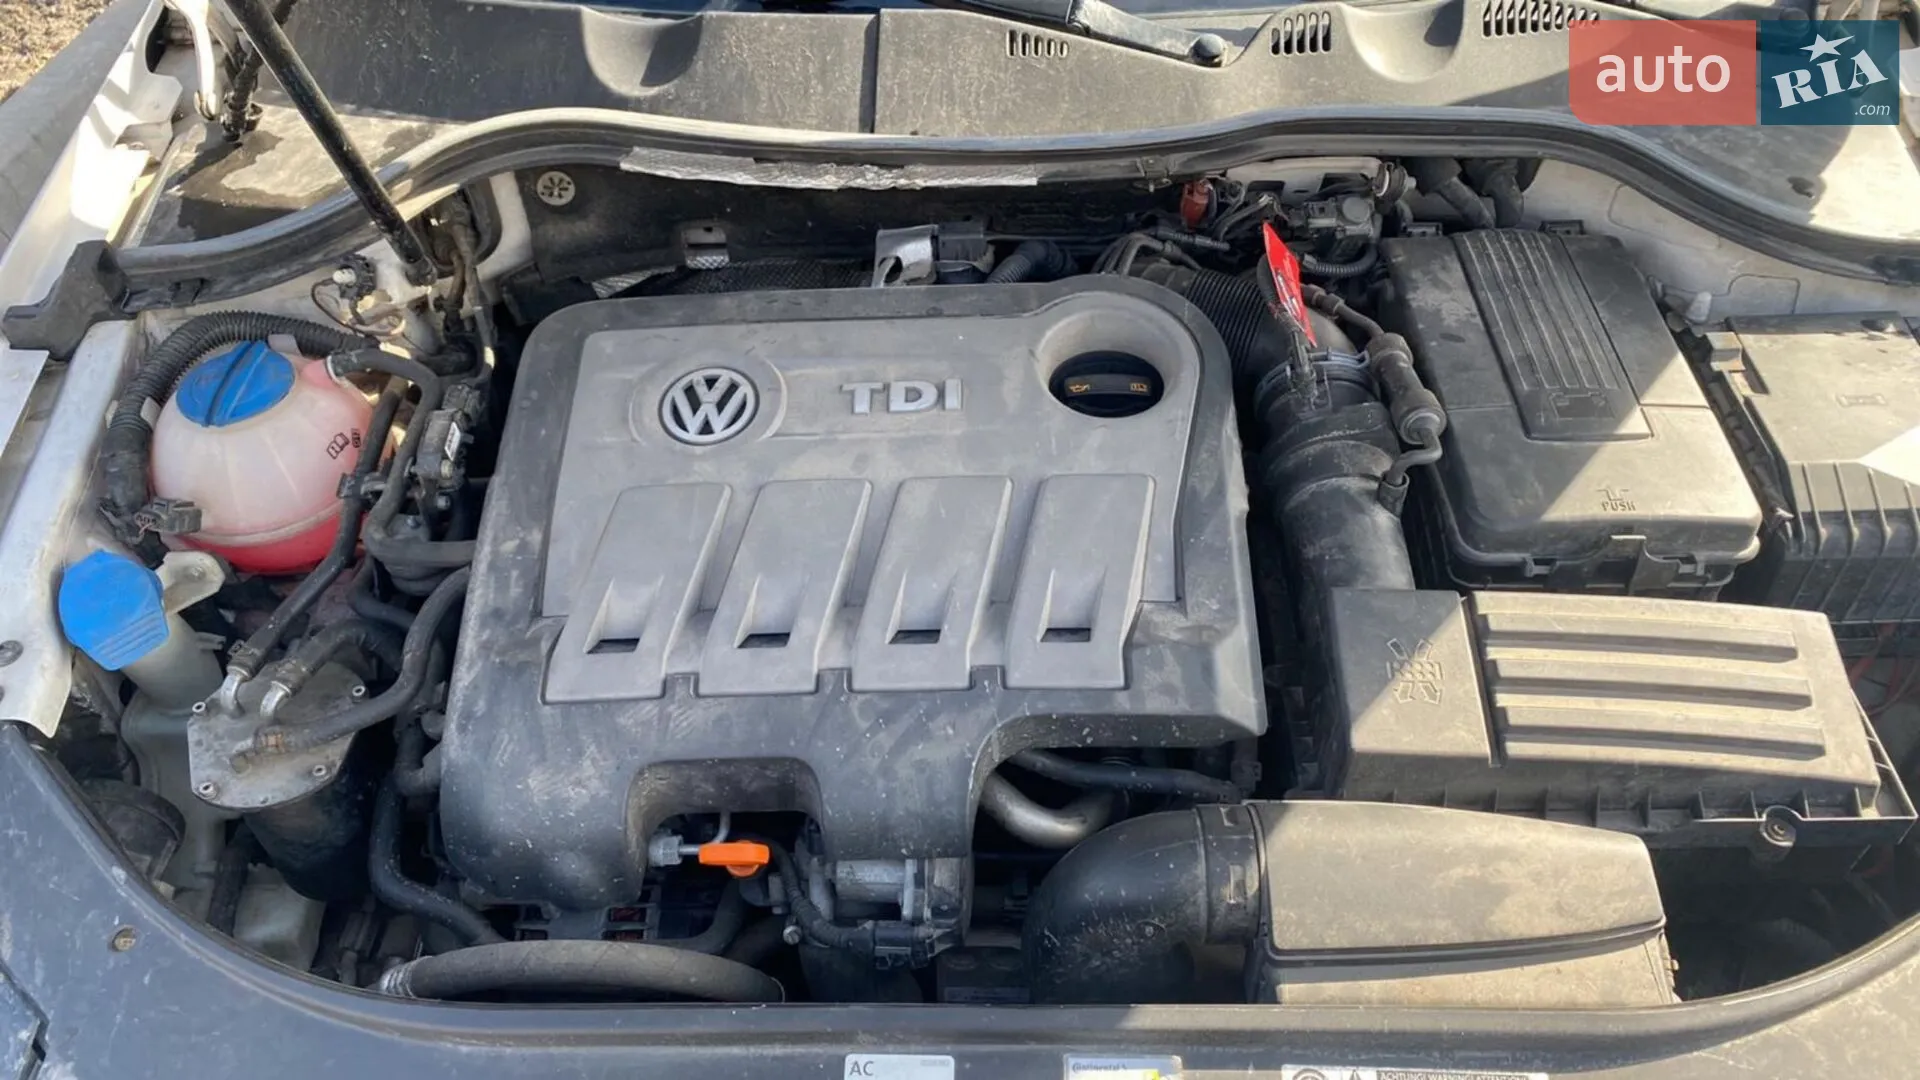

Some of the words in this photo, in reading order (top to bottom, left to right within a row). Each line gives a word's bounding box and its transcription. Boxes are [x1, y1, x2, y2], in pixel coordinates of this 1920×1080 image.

[842, 378, 963, 415] TDI
[659, 367, 760, 446] VW
[1601, 501, 1636, 511] PUSH
[849, 1060, 874, 1076] AC
[1072, 1062, 1120, 1074] Continental
